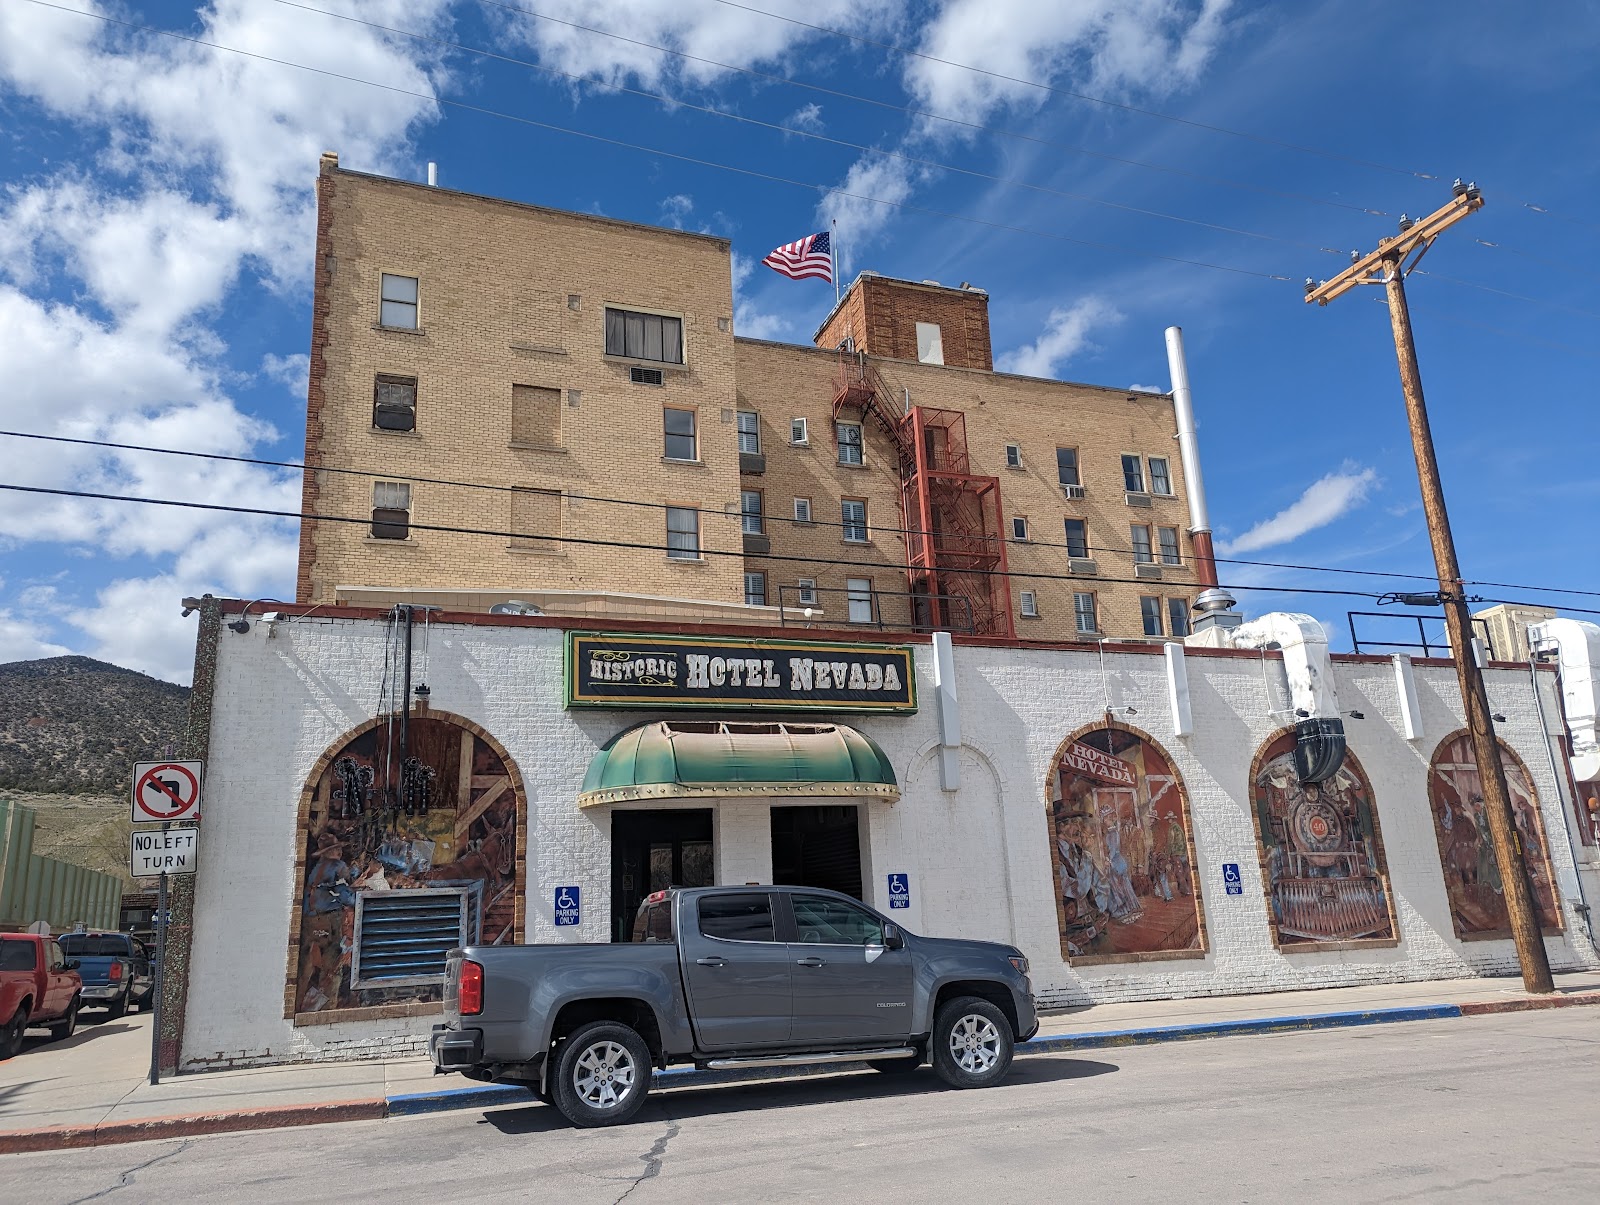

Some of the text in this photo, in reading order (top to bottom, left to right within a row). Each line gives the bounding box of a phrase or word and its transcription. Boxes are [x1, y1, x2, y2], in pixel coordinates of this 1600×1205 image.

[590, 654, 902, 692] HISTORIC HOTEL NEVADA
[1073, 743, 1128, 772] HOTEL
[1061, 752, 1135, 784] NEVADA
[135, 836, 194, 851] NO LEFT
[143, 855, 186, 869] TURN
[894, 900, 905, 908] ONLY
[556, 909, 578, 917] PARKING
[560, 916, 574, 924] ONLY
